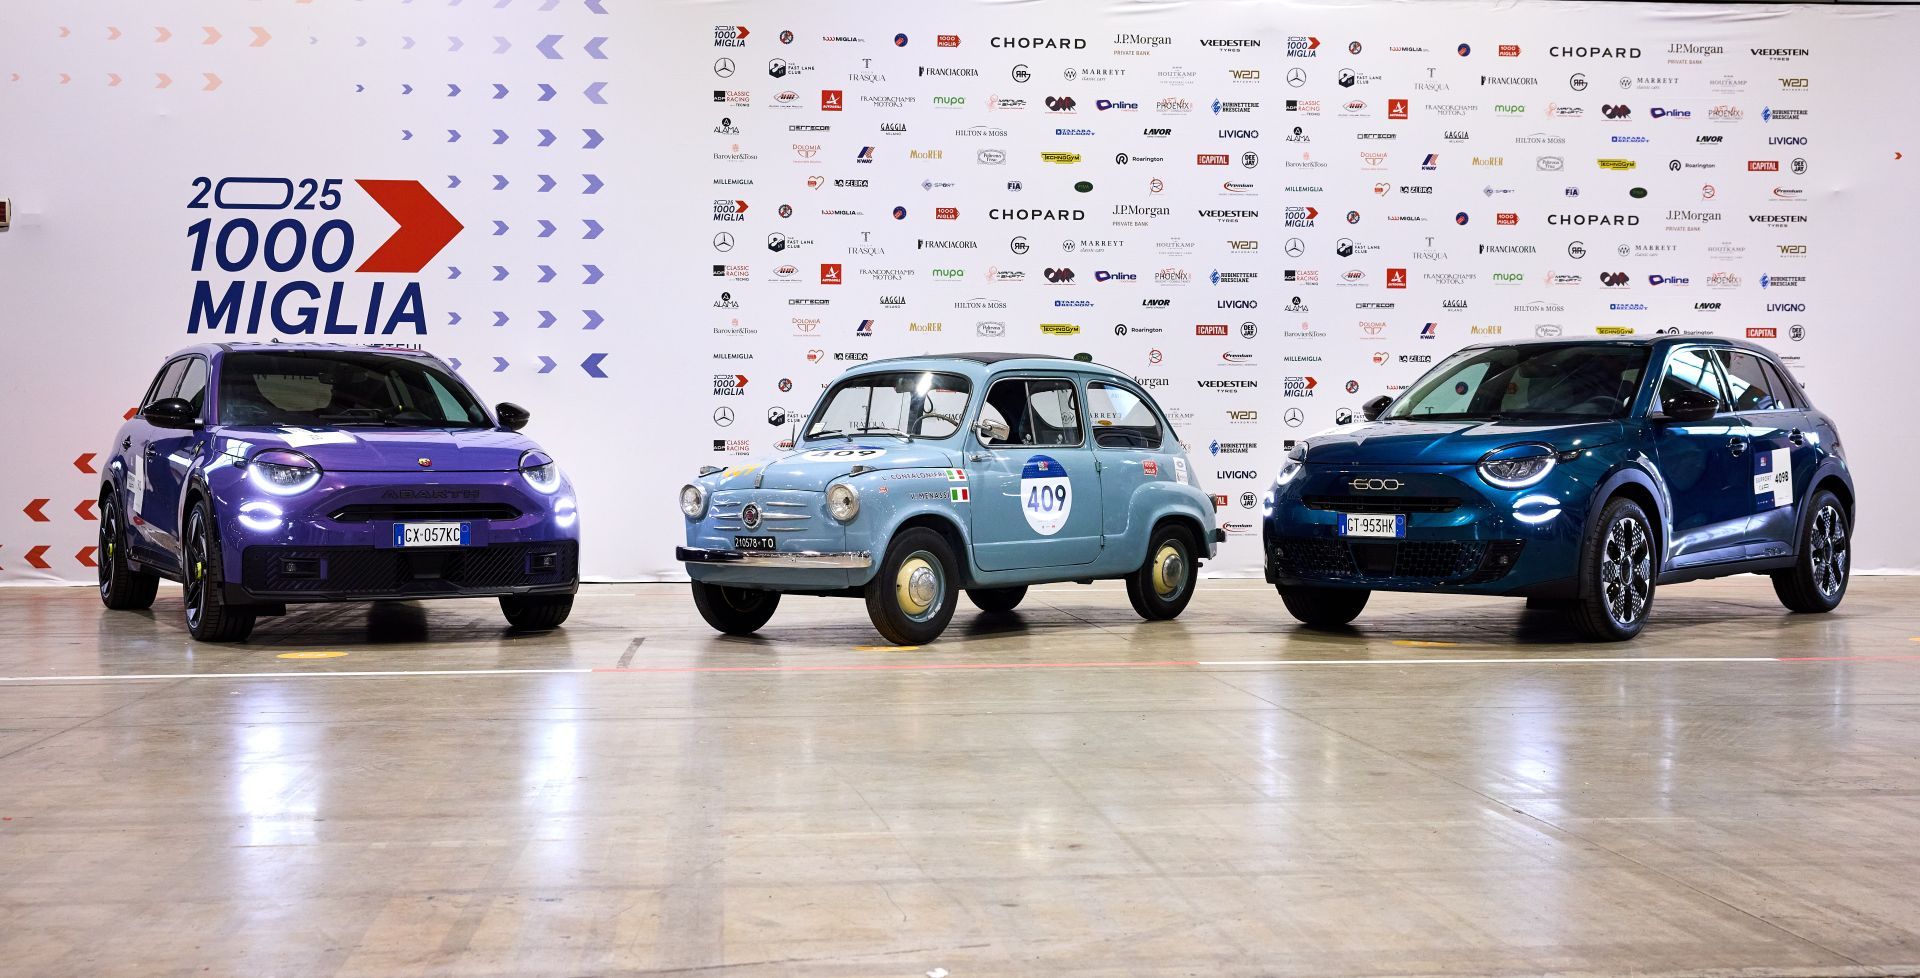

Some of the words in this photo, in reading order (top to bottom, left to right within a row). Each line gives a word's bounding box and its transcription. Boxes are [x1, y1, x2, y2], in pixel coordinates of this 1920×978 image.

[714, 31, 736, 39] 1000
[714, 39, 745, 47] MIGLIA
[990, 37, 1086, 49] CHOPARD
[1114, 34, 1171, 47] J.P.Morgan
[1199, 39, 1261, 47] VREDESTEIN
[1287, 49, 1317, 58] MIGLIA
[1549, 47, 1641, 59] CHOPARD
[1667, 43, 1723, 56] J.P.Morgan
[926, 67, 979, 77] FRANCIACORTA
[1082, 68, 1125, 76] MARREYT
[848, 73, 885, 83] TRASQUA
[1488, 76, 1538, 85] FRANCIACORTA
[1414, 83, 1449, 92] TRASQUA
[934, 96, 965, 106] mupa
[1495, 104, 1525, 114] mupa
[713, 126, 739, 134] ALAMA
[1143, 128, 1171, 136] LAVOR
[1219, 130, 1259, 139] LIVIGNO
[1769, 137, 1808, 145] LIVIGNO
[1201, 155, 1227, 164] CAPITAL
[1752, 162, 1777, 170] CAPITAL
[1008, 182, 1021, 190] FIA
[1400, 186, 1409, 194] LA
[186, 176, 343, 210] 2025
[1565, 188, 1578, 196] FIA
[713, 205, 735, 213] 1000
[1112, 205, 1170, 218] J.P.Morgan
[713, 213, 744, 221] MIGLIA
[989, 209, 1085, 221] CHOPARD
[1198, 210, 1259, 218] VREDESTEIN
[1665, 210, 1721, 223] J.P.Morgan
[1285, 219, 1314, 227] MIGLIA
[1547, 215, 1639, 226] CHOPARD
[186, 217, 355, 273] 1000
[925, 241, 978, 249] FRANCIACORTA
[1486, 244, 1536, 253] FRANCIACORTA
[848, 248, 885, 257] TRASQUA
[1413, 251, 1448, 260] TRASQUA
[933, 268, 964, 278] mupa
[1493, 273, 1523, 282] mupa
[713, 300, 739, 308] ALAMA
[880, 296, 906, 304] GAGGIA
[1217, 300, 1258, 309] LIVIGNO
[186, 281, 428, 335] MIGLIA
[1767, 304, 1806, 312] LIVIGNO
[1200, 326, 1226, 334] CAPITAL
[1751, 329, 1775, 337] CAPITAL
[713, 387, 744, 396] MIGLIA
[1217, 471, 1257, 479] LIVIGNO
[381, 489, 480, 498] ABARTH
[1028, 485, 1066, 512] 409
